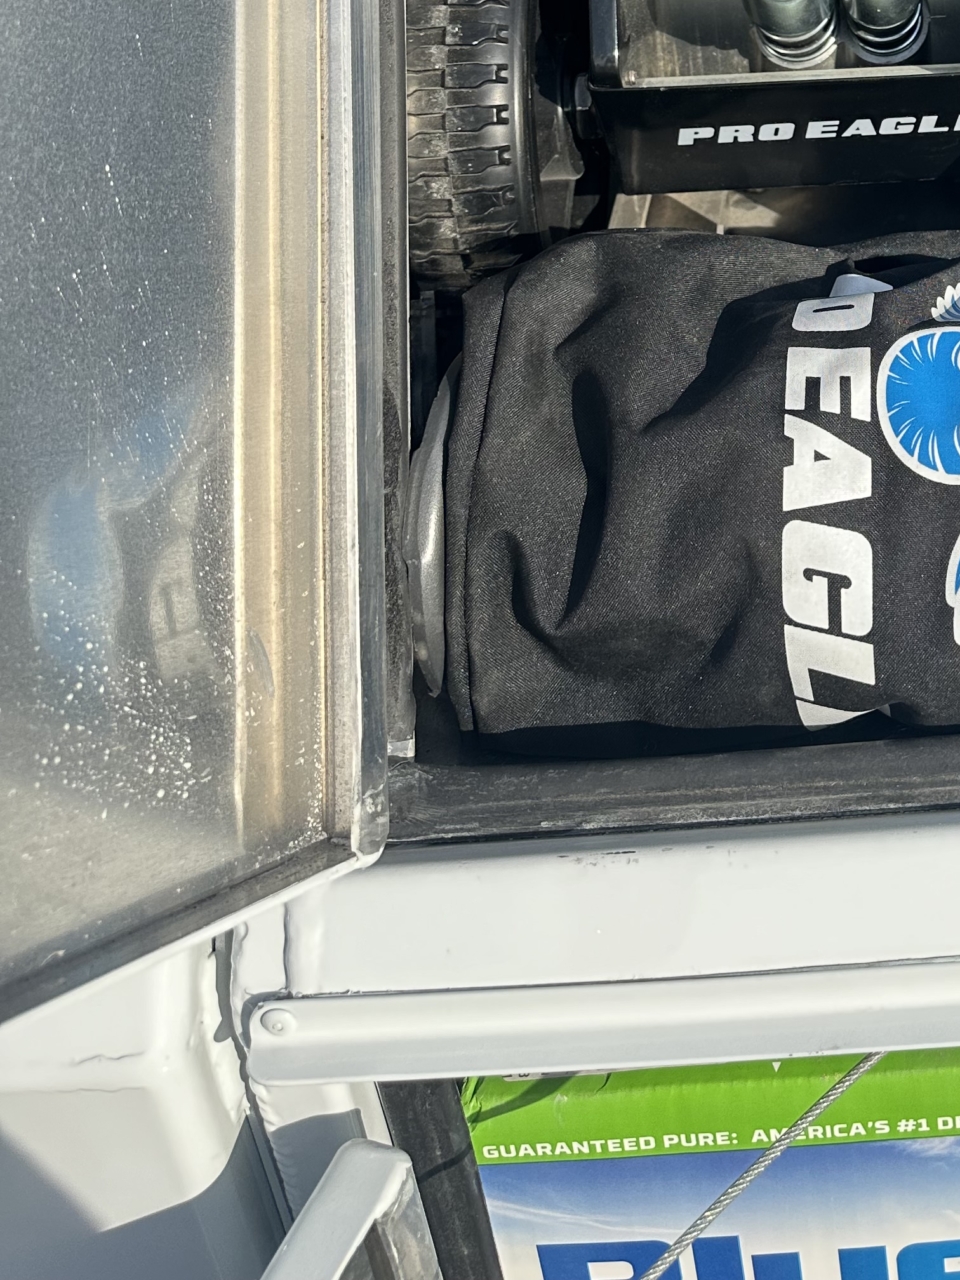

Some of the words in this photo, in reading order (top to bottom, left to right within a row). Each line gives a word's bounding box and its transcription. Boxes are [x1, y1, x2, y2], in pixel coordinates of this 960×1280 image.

[677, 122, 795, 146] PRO
[482, 1136, 656, 1158] GUARANTEED
[663, 1131, 739, 1148] PURE:
[897, 1118, 931, 1133] #1
